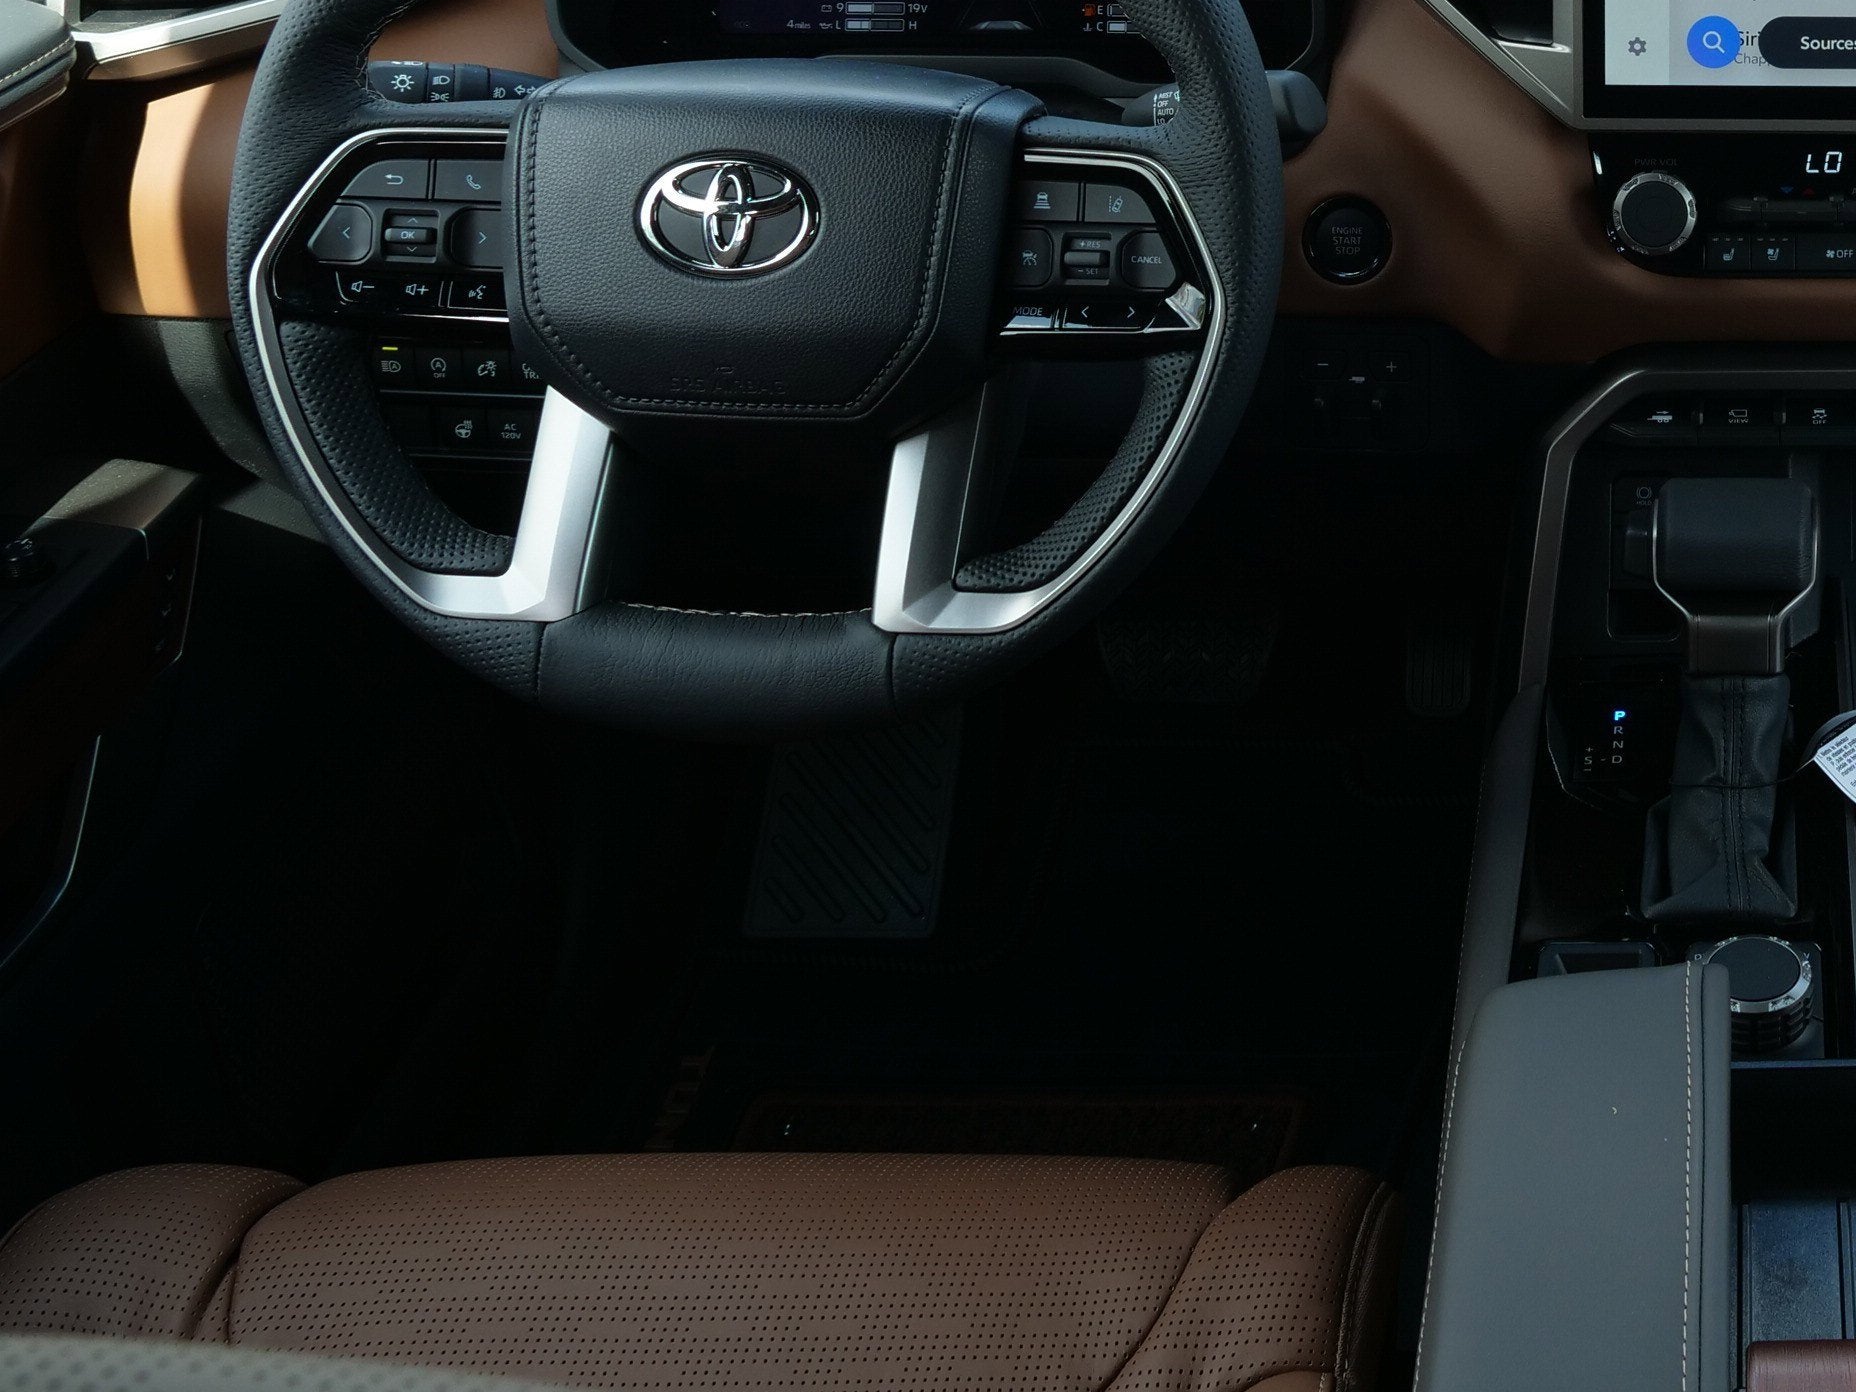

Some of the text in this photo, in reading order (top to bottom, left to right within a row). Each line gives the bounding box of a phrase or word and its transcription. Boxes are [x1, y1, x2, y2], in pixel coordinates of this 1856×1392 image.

[401, 229, 415, 240] OK
[1331, 226, 1362, 235] ENGINE
[1332, 236, 1361, 245] START
[1335, 246, 1360, 255] STOP
[1836, 249, 1854, 259] OFF
[1131, 256, 1162, 264] CANCEL
[1013, 306, 1043, 316] MODE
[1728, 417, 1749, 425] VIEW
[1614, 709, 1626, 721] P
[1613, 725, 1623, 735] R
[1612, 740, 1623, 749] N
[1611, 755, 1623, 765] D
